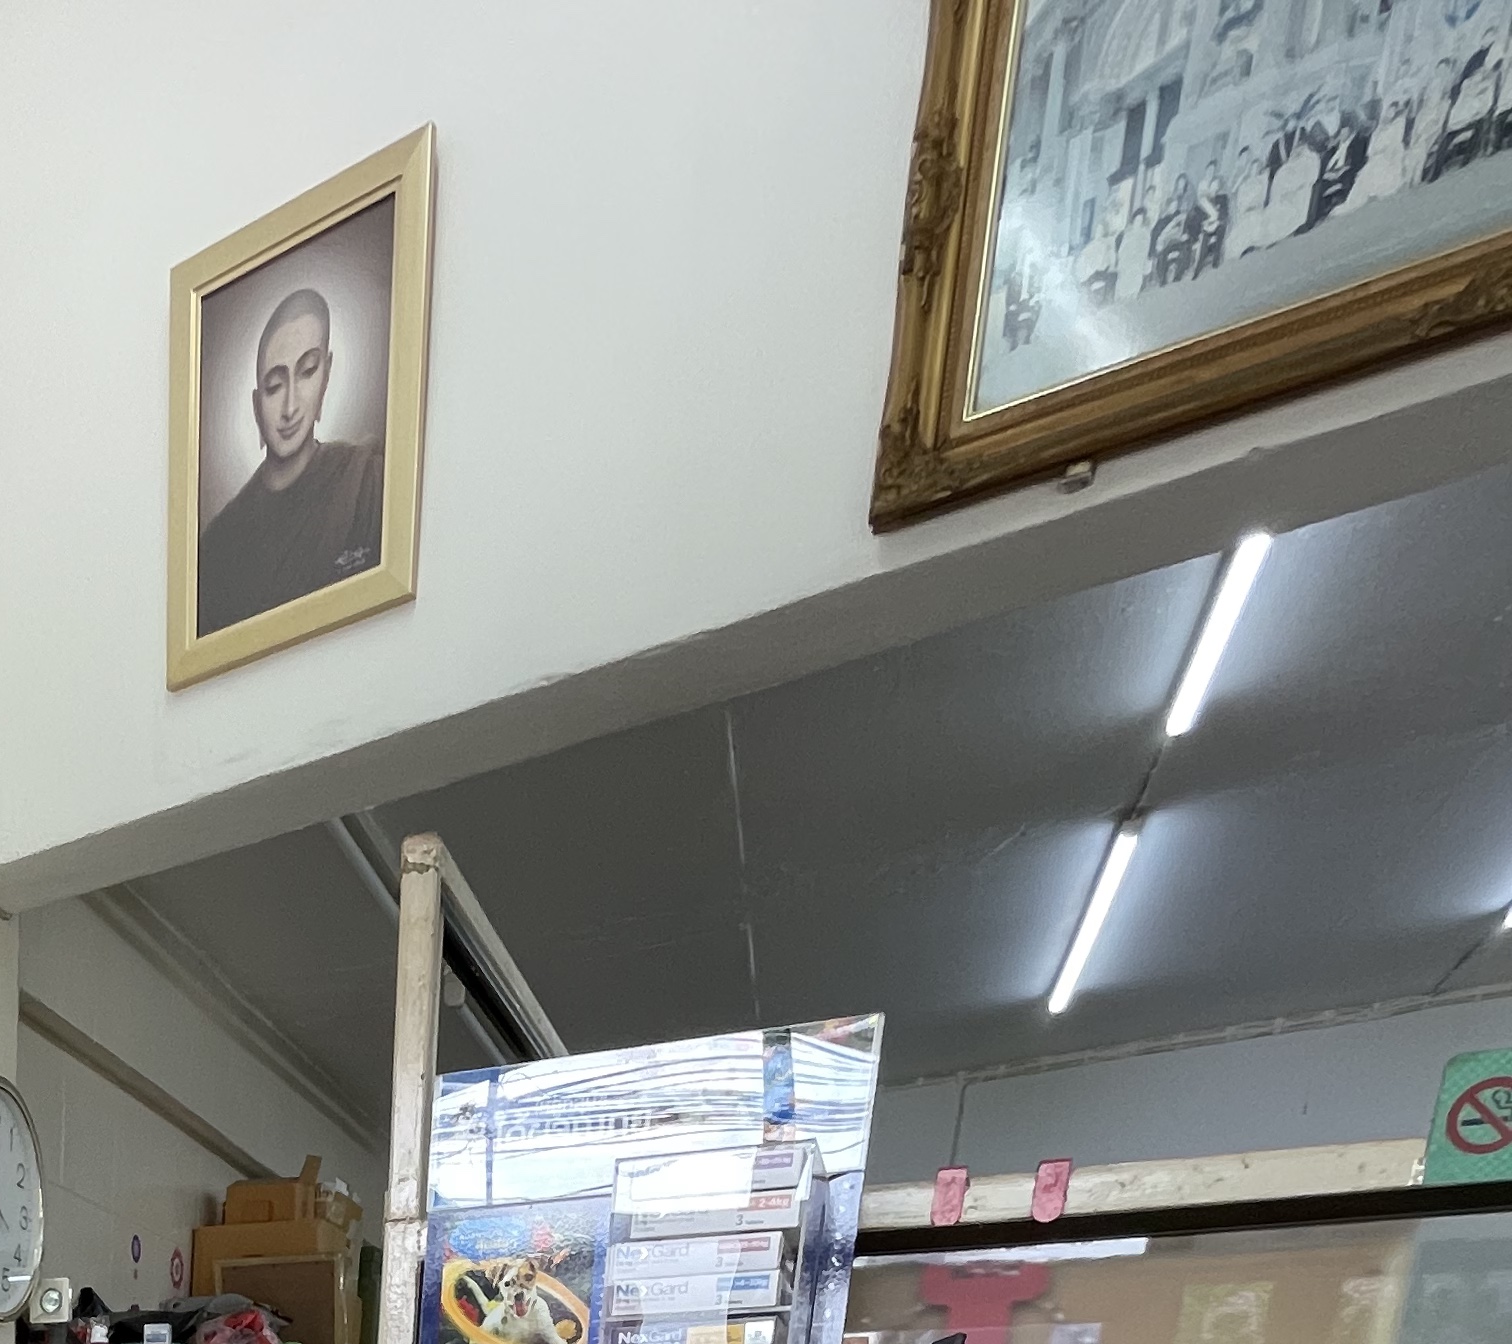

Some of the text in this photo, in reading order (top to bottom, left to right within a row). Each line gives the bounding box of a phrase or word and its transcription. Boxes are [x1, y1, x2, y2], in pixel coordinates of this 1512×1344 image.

[16, 1163, 26, 1190] 2
[18, 1206, 29, 1231] 3
[13, 1244, 23, 1268] 4
[1, 1267, 11, 1292] 5
[618, 1327, 683, 1344] NexGard
